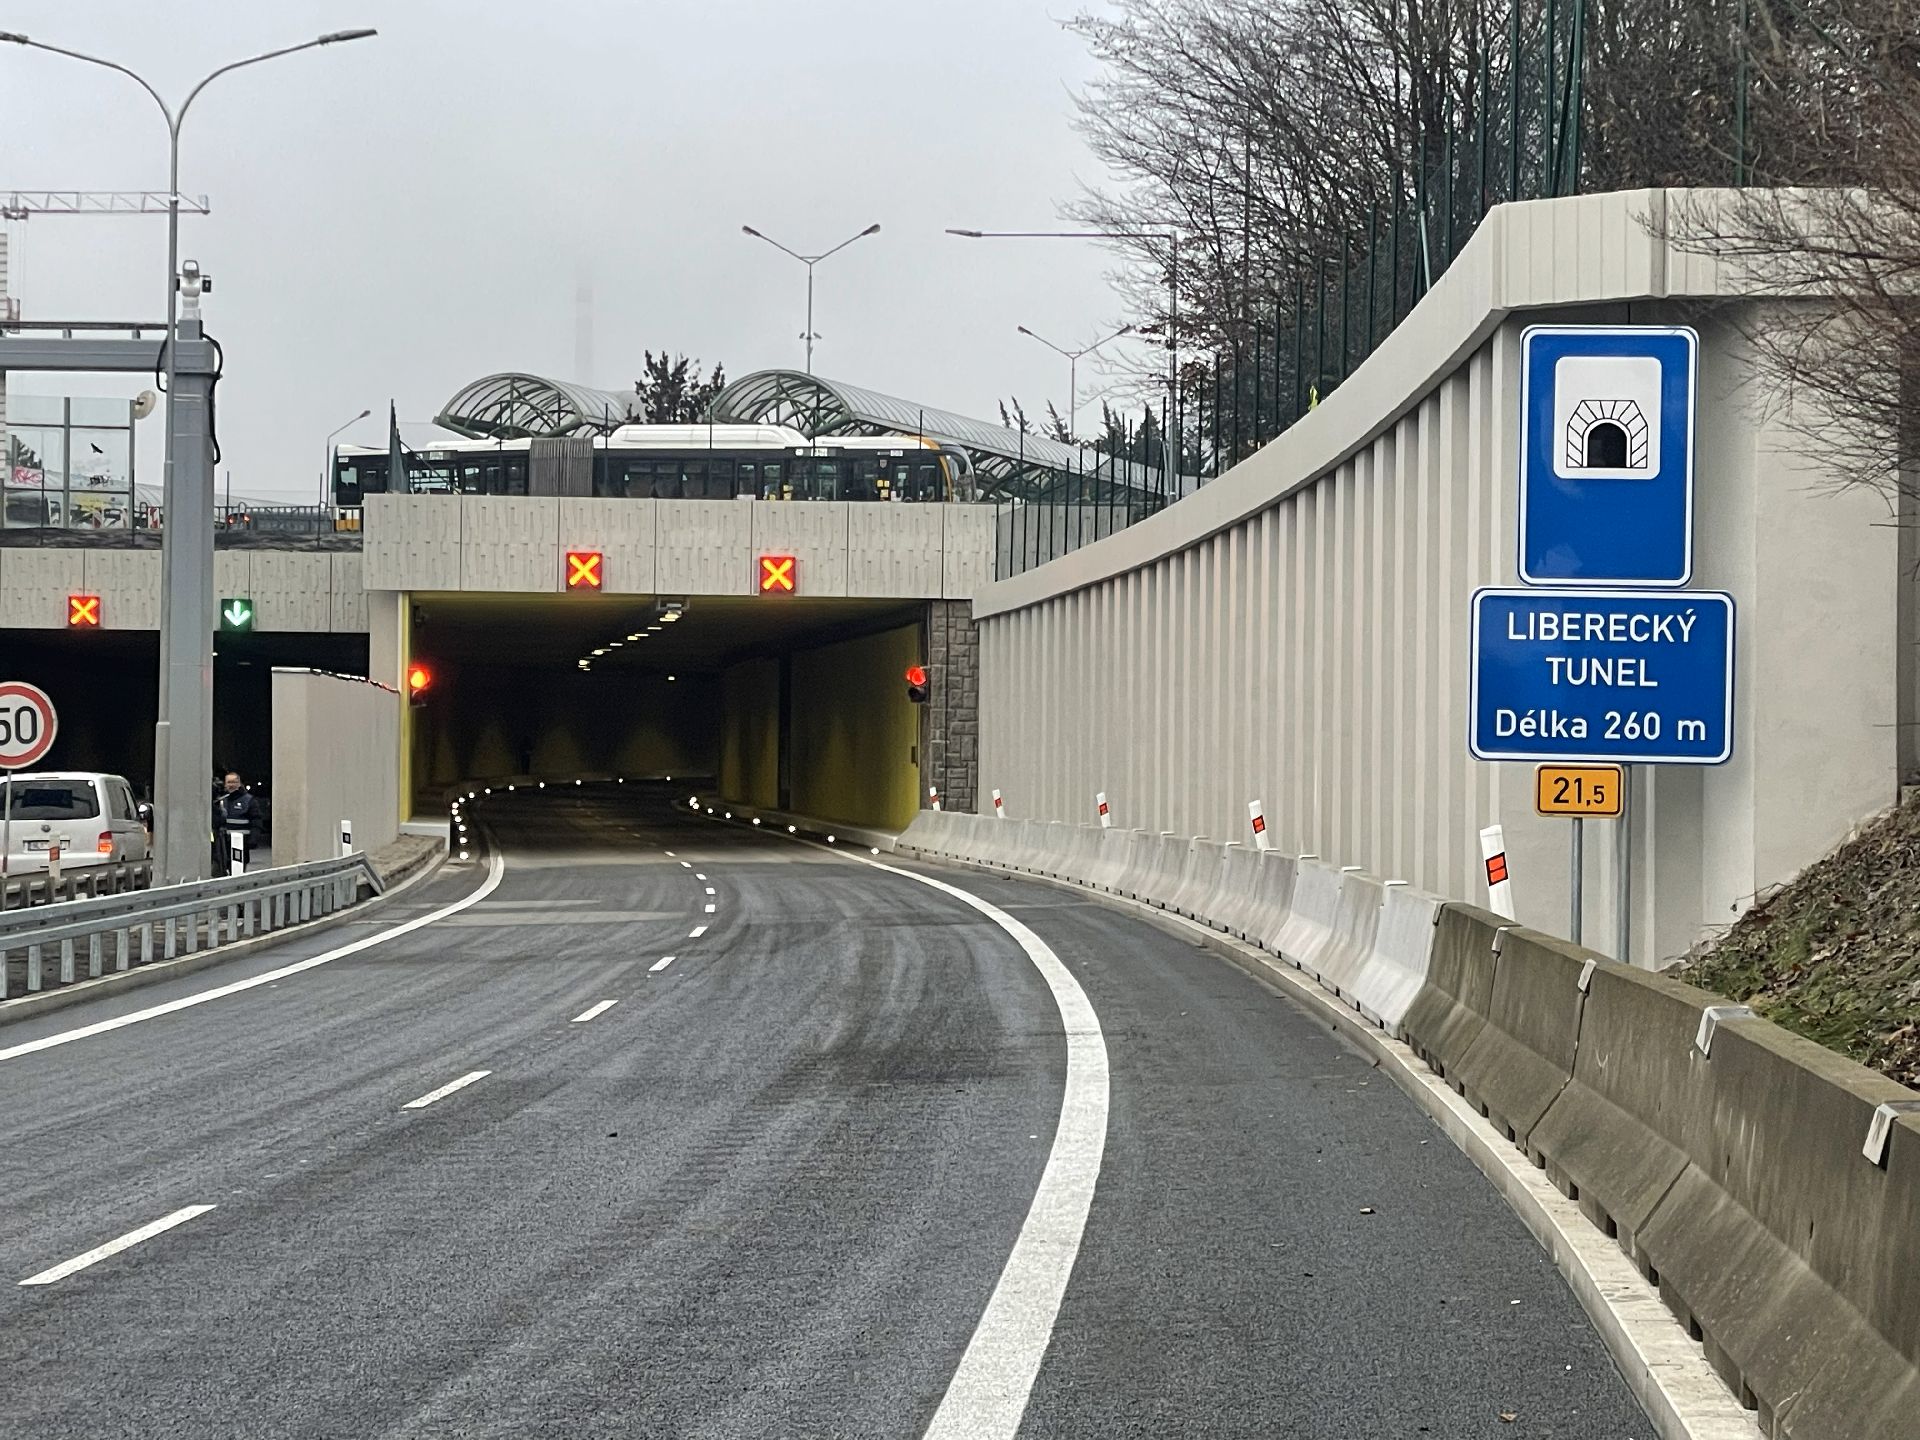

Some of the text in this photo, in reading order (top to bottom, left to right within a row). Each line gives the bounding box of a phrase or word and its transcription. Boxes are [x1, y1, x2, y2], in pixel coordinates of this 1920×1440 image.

[1507, 609, 1697, 643] LIBERECKÝ
[1546, 657, 1658, 687] TUNEL
[1496, 709, 1706, 741] Délka 260 m
[1553, 777, 1605, 807] 21,5
